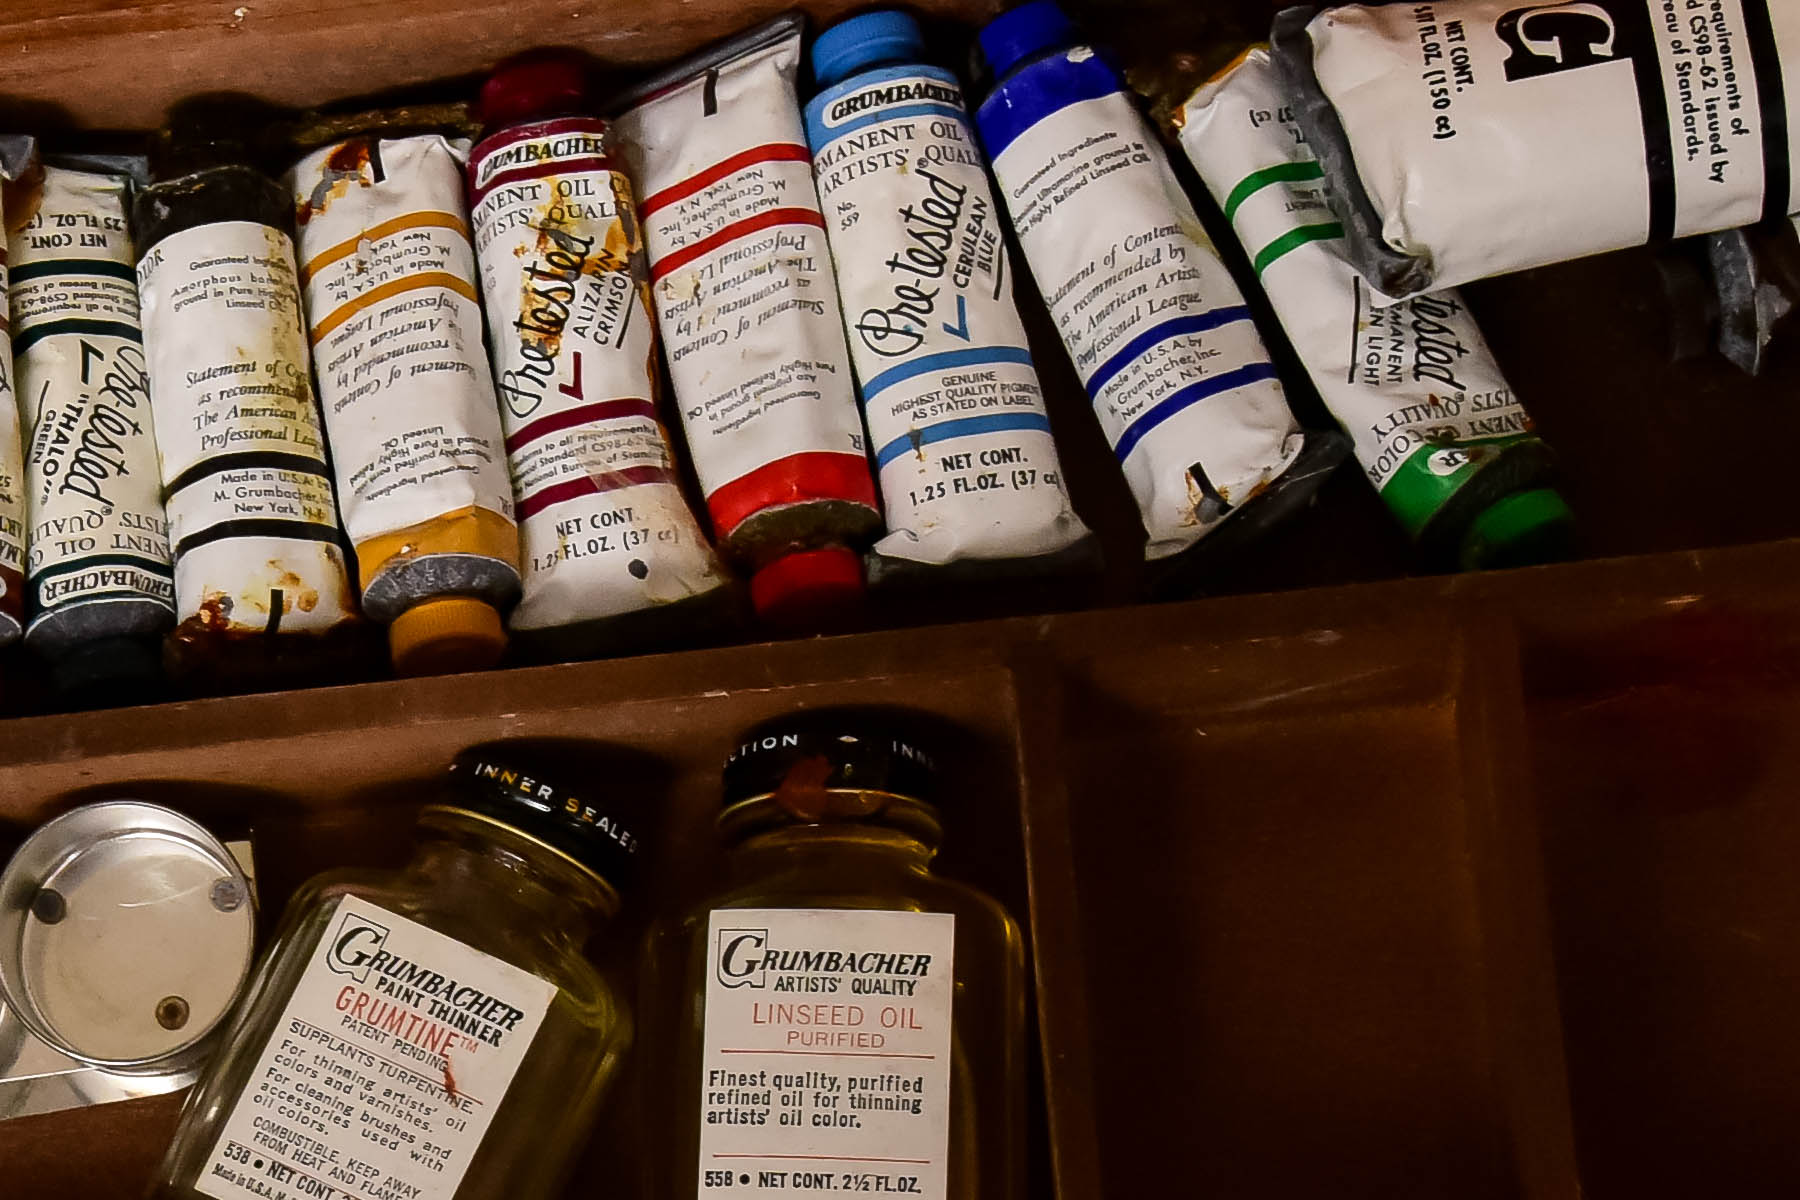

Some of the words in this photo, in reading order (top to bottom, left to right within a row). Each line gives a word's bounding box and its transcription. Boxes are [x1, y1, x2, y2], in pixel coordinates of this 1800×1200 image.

[1443, 20, 1465, 43] NET
[1671, 39, 1691, 55] of
[1450, 46, 1475, 93] CONT.
[1689, 15, 1720, 91] CS98-62
[1422, 69, 1452, 110] (150
[930, 121, 963, 142] OIL
[1675, 61, 1704, 162] Standards.
[1704, 97, 1728, 156] issued
[1730, 117, 1750, 136] of
[556, 178, 596, 198] OIL
[822, 148, 910, 198] ARTISTS'
[1708, 160, 1729, 184] by
[23, 233, 73, 250] CONT.
[79, 233, 108, 248] NET
[952, 196, 988, 289] CERULEAN
[977, 230, 997, 275] BLUE
[573, 248, 615, 339] ALIZARIN
[1073, 248, 1162, 315] recommended
[593, 261, 633, 347] CRIMSON
[1087, 283, 1148, 334] American
[370, 318, 443, 348] American
[941, 371, 998, 388] GENUINE
[1180, 365, 1209, 381] N.Y.
[1363, 335, 1383, 387] LIGHT
[945, 383, 997, 401] QUALITY
[200, 426, 288, 451] Professional
[1371, 396, 1461, 444] QUALITY
[941, 453, 972, 473] NET
[980, 447, 1029, 467] CONT.
[1367, 428, 1424, 484] COLOR
[909, 481, 946, 507] 1.25
[953, 473, 1005, 494] FL.OZ.
[54, 537, 96, 557] OIL
[555, 518, 583, 539] NET
[43, 570, 174, 601] GRUMBACHER
[475, 762, 553, 800] INNER
[721, 934, 933, 978] GRUMBACHER
[334, 926, 525, 1033] GRUMBACHER
[773, 975, 843, 994] ARTISTS'
[851, 976, 918, 997] QUALITY
[375, 976, 426, 1009] PAINT
[426, 999, 504, 1048] THINNER
[752, 1002, 865, 1026] LINSEED
[879, 1006, 923, 1030] OIL
[288, 1020, 376, 1068] SUPPLANTS
[340, 1014, 390, 1045] PATENT
[391, 1038, 450, 1073] PENDING
[786, 1029, 886, 1049] PURIFIED
[273, 1053, 319, 1079] colors
[323, 1075, 352, 1095] and
[358, 1090, 434, 1134] varnishes.
[280, 1038, 307, 1058] For
[313, 1052, 377, 1092] thinning
[382, 1083, 438, 1116] artists'
[445, 1115, 467, 1133] oil
[708, 1069, 767, 1089] Finest
[772, 1071, 842, 1093] quality,
[847, 1073, 924, 1094] purified
[252, 1093, 274, 1110] oil
[277, 1103, 330, 1136] colors.
[265, 1066, 290, 1086] For
[294, 1080, 353, 1117] cleaning
[359, 1110, 417, 1145] brushes
[422, 1140, 452, 1160] and
[706, 1107, 771, 1126] artists'
[779, 1109, 803, 1127] oil
[811, 1110, 863, 1129] color.
[707, 1090, 772, 1107] refined
[780, 1091, 804, 1108] oil
[812, 1091, 841, 1109] for
[847, 1094, 923, 1115] thinning
[260, 1080, 352, 1130] accessories
[361, 1127, 402, 1151] used
[408, 1149, 445, 1173] with
[211, 1162, 236, 1183] Made
[235, 1172, 246, 1187] in
[223, 1142, 251, 1165] 538
[265, 1160, 297, 1185] NET
[252, 1116, 341, 1165] COMBUSTIBLE.
[346, 1157, 381, 1181] KEEP
[382, 1175, 422, 1200] AWAY
[252, 1131, 290, 1156] FROM
[290, 1149, 327, 1173] HEAT
[327, 1165, 358, 1186] AND
[704, 1170, 734, 1189] 558
[757, 1171, 789, 1189] NET
[791, 1172, 839, 1192] CONT.
[842, 1173, 870, 1192] 2½
[874, 1175, 923, 1195] FL.OZ.
